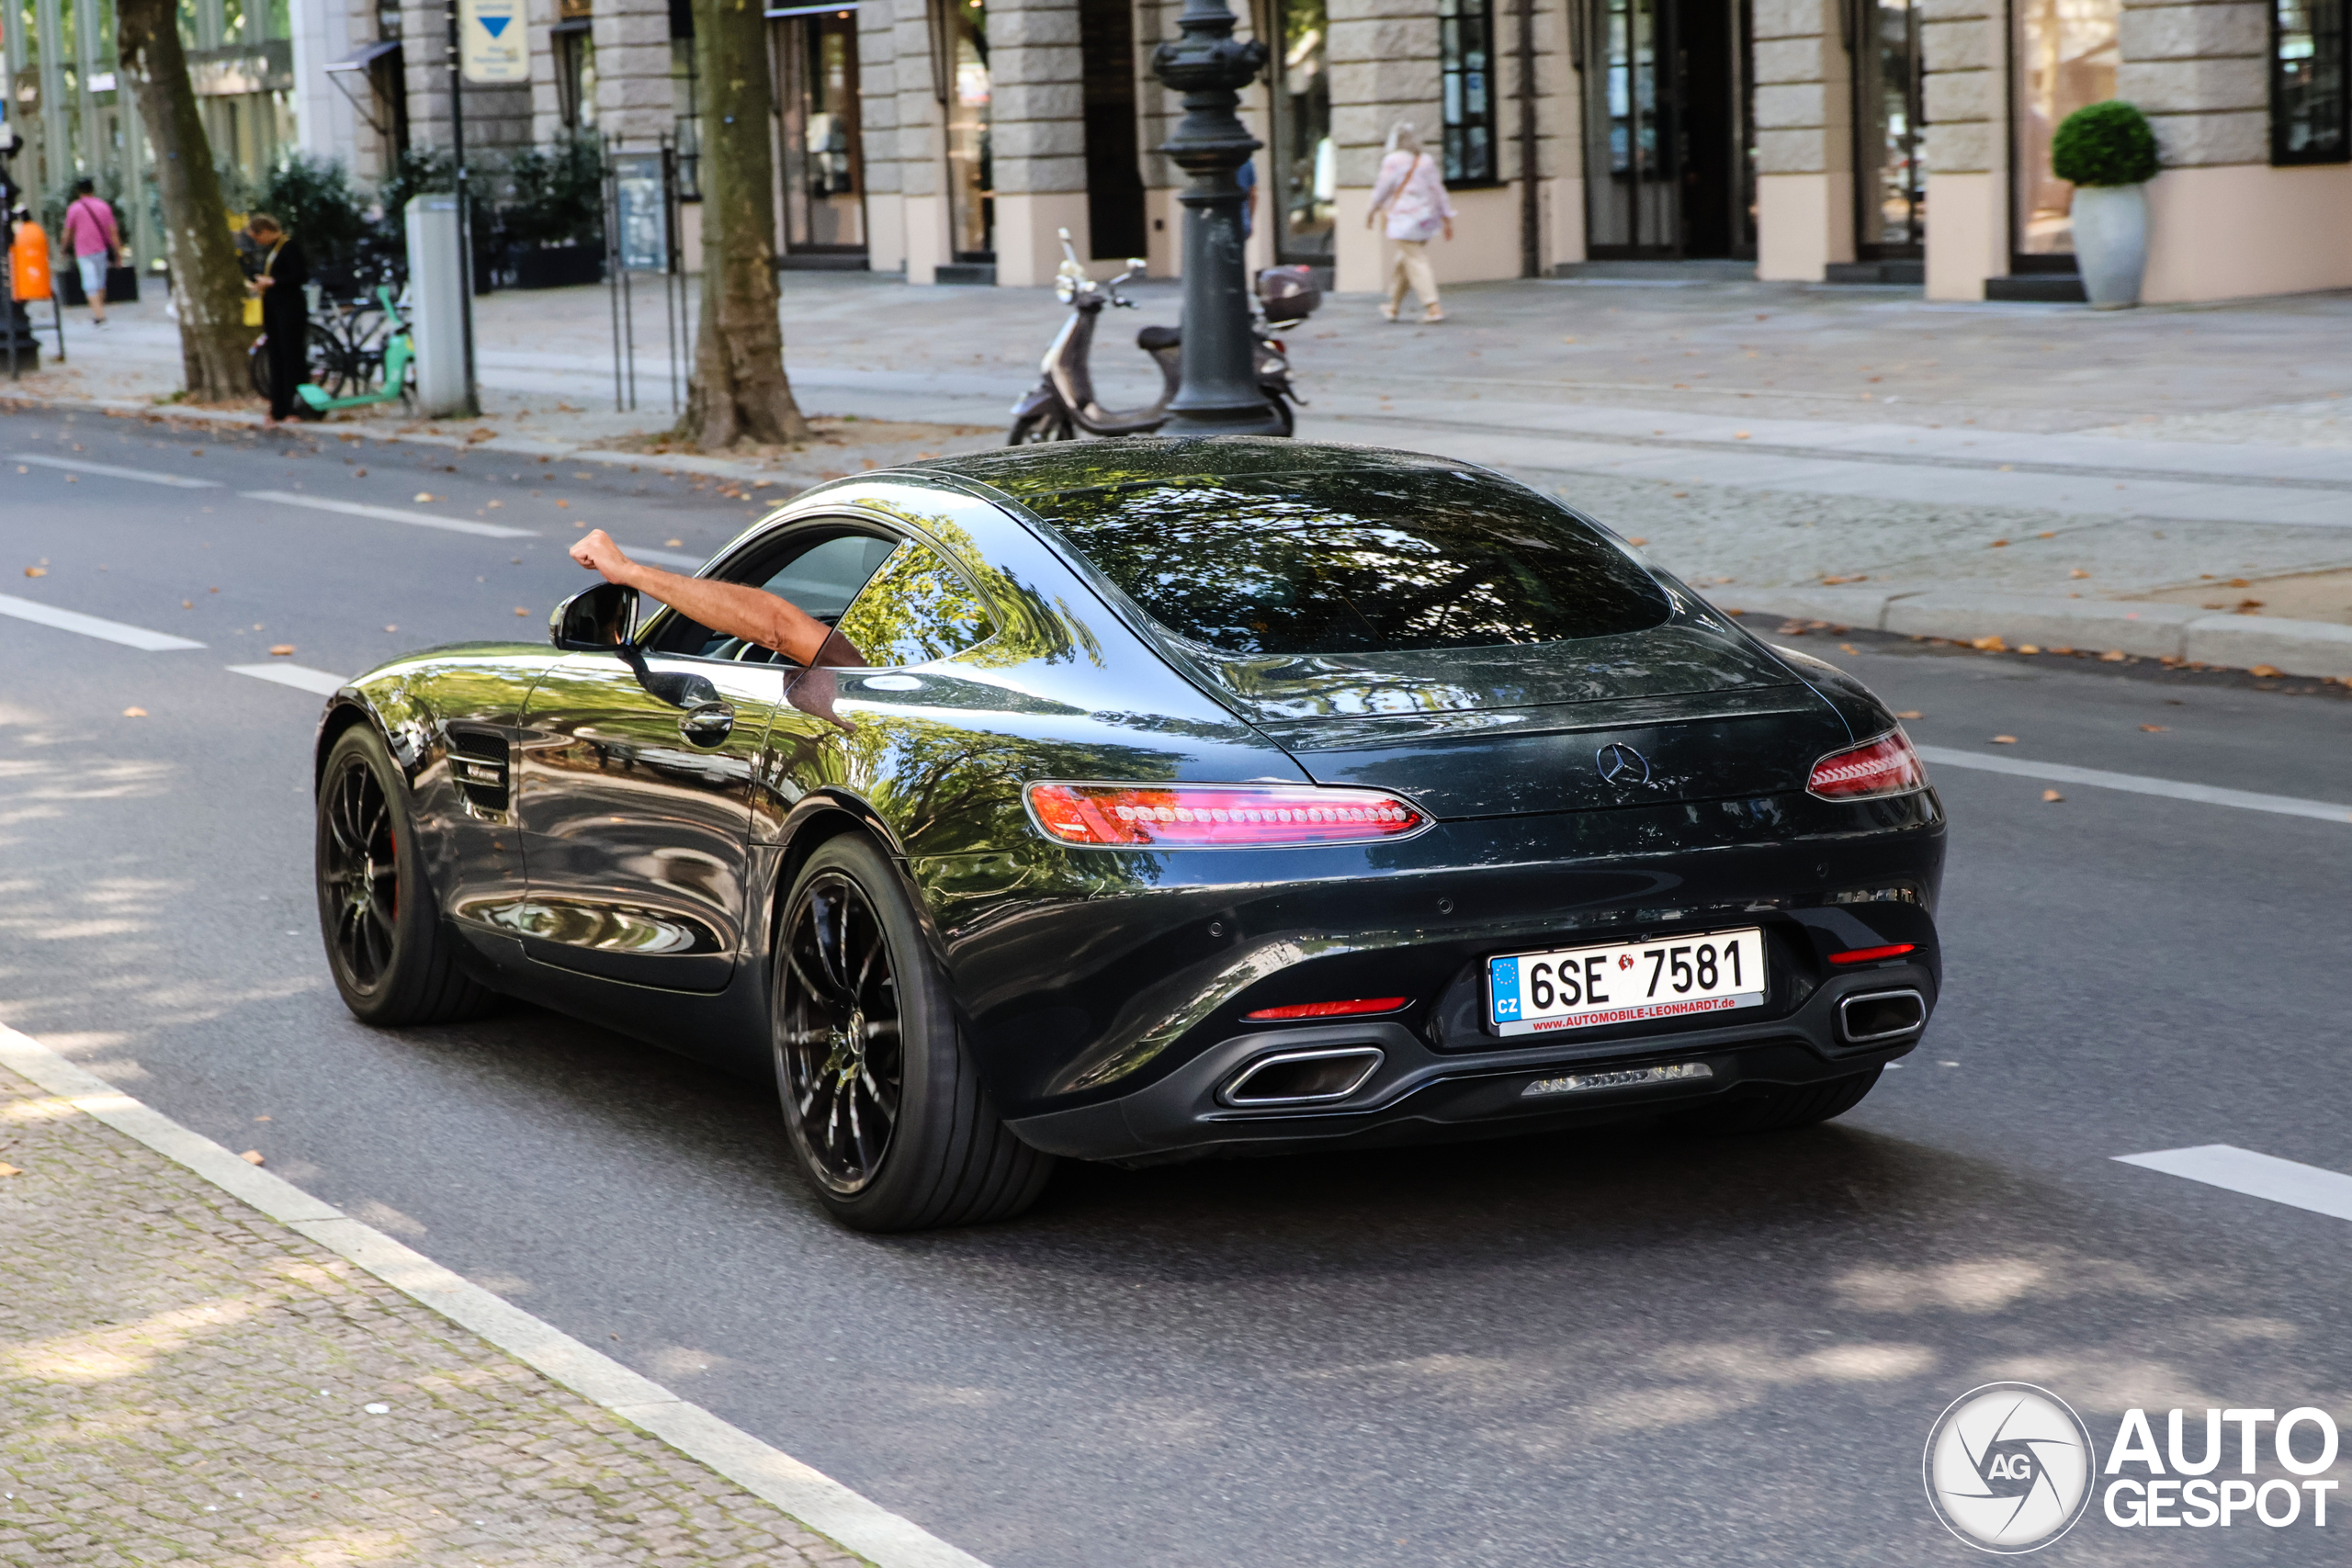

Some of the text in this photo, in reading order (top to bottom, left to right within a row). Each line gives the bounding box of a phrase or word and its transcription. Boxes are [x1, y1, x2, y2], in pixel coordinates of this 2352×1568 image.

[1531, 940, 1742, 1010] 6SE 7581
[1498, 998, 1518, 1014] CZ
[1532, 998, 1736, 1031] www.AUTOMOBILE-LEONHARDT.de
